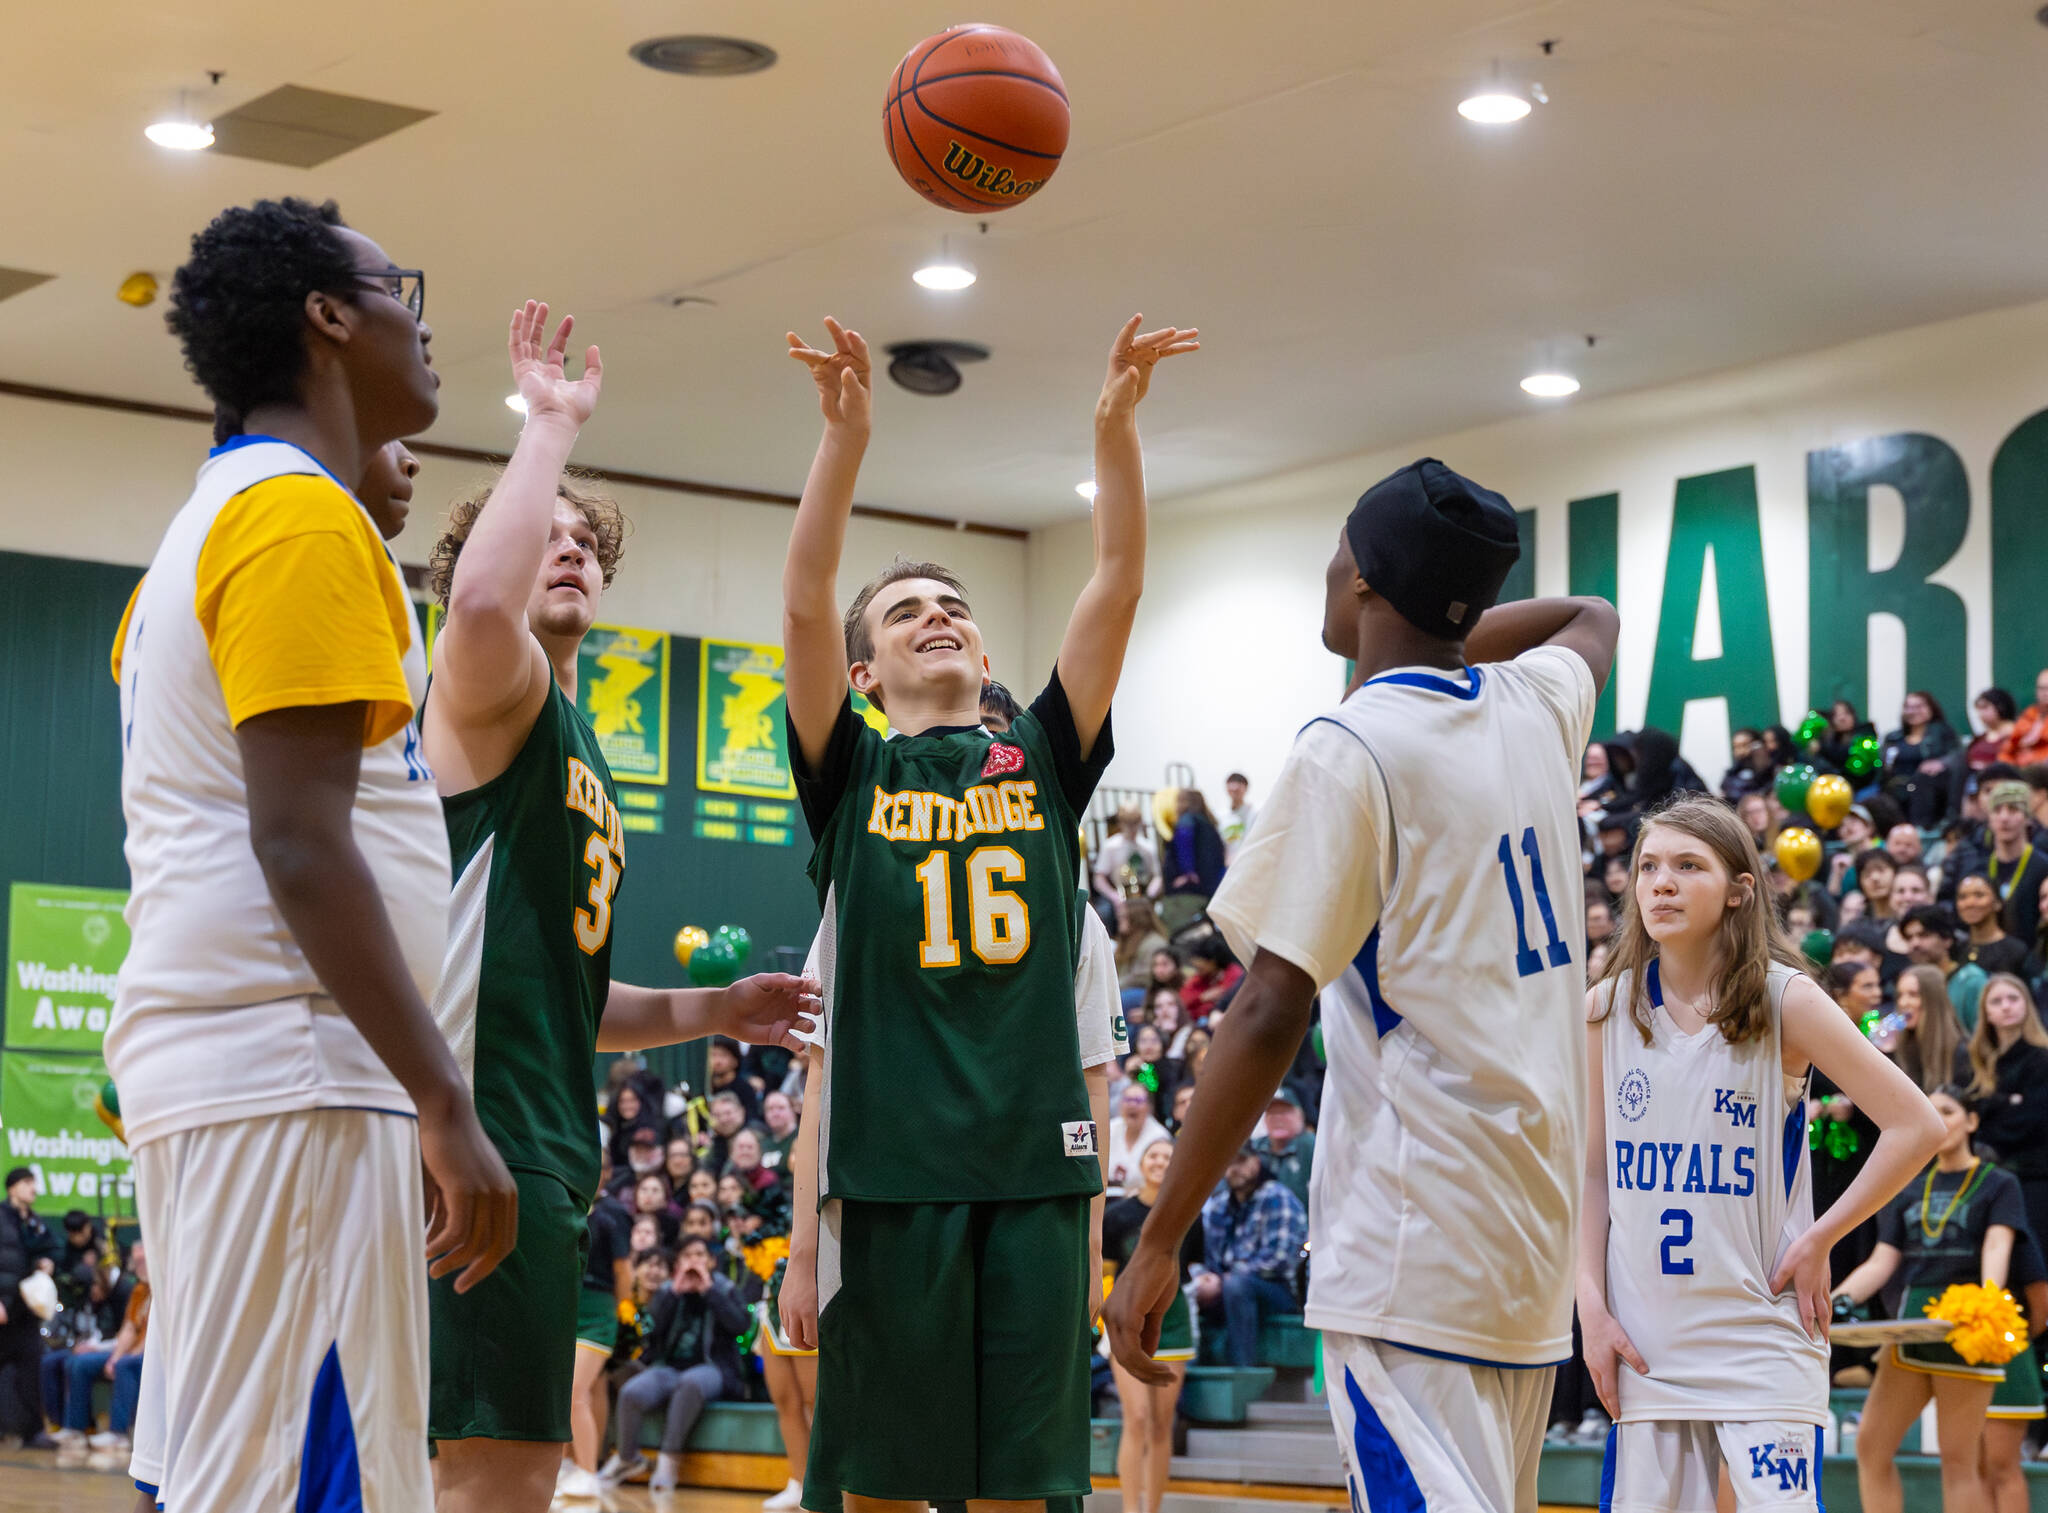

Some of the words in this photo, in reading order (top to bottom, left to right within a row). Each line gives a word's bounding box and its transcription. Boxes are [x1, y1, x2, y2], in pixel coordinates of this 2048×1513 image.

[868, 781, 1045, 842] KENTRIDGE
[574, 830, 621, 956] 3
[916, 846, 1031, 968] 16
[1497, 826, 1572, 978] 11
[1110, 1015, 1128, 1042] S
[1713, 1088, 1757, 1128] KM
[1615, 1140, 1756, 1198] ROYALS
[1659, 1208, 1695, 1276] 2
[1748, 1443, 1808, 1492] KM
